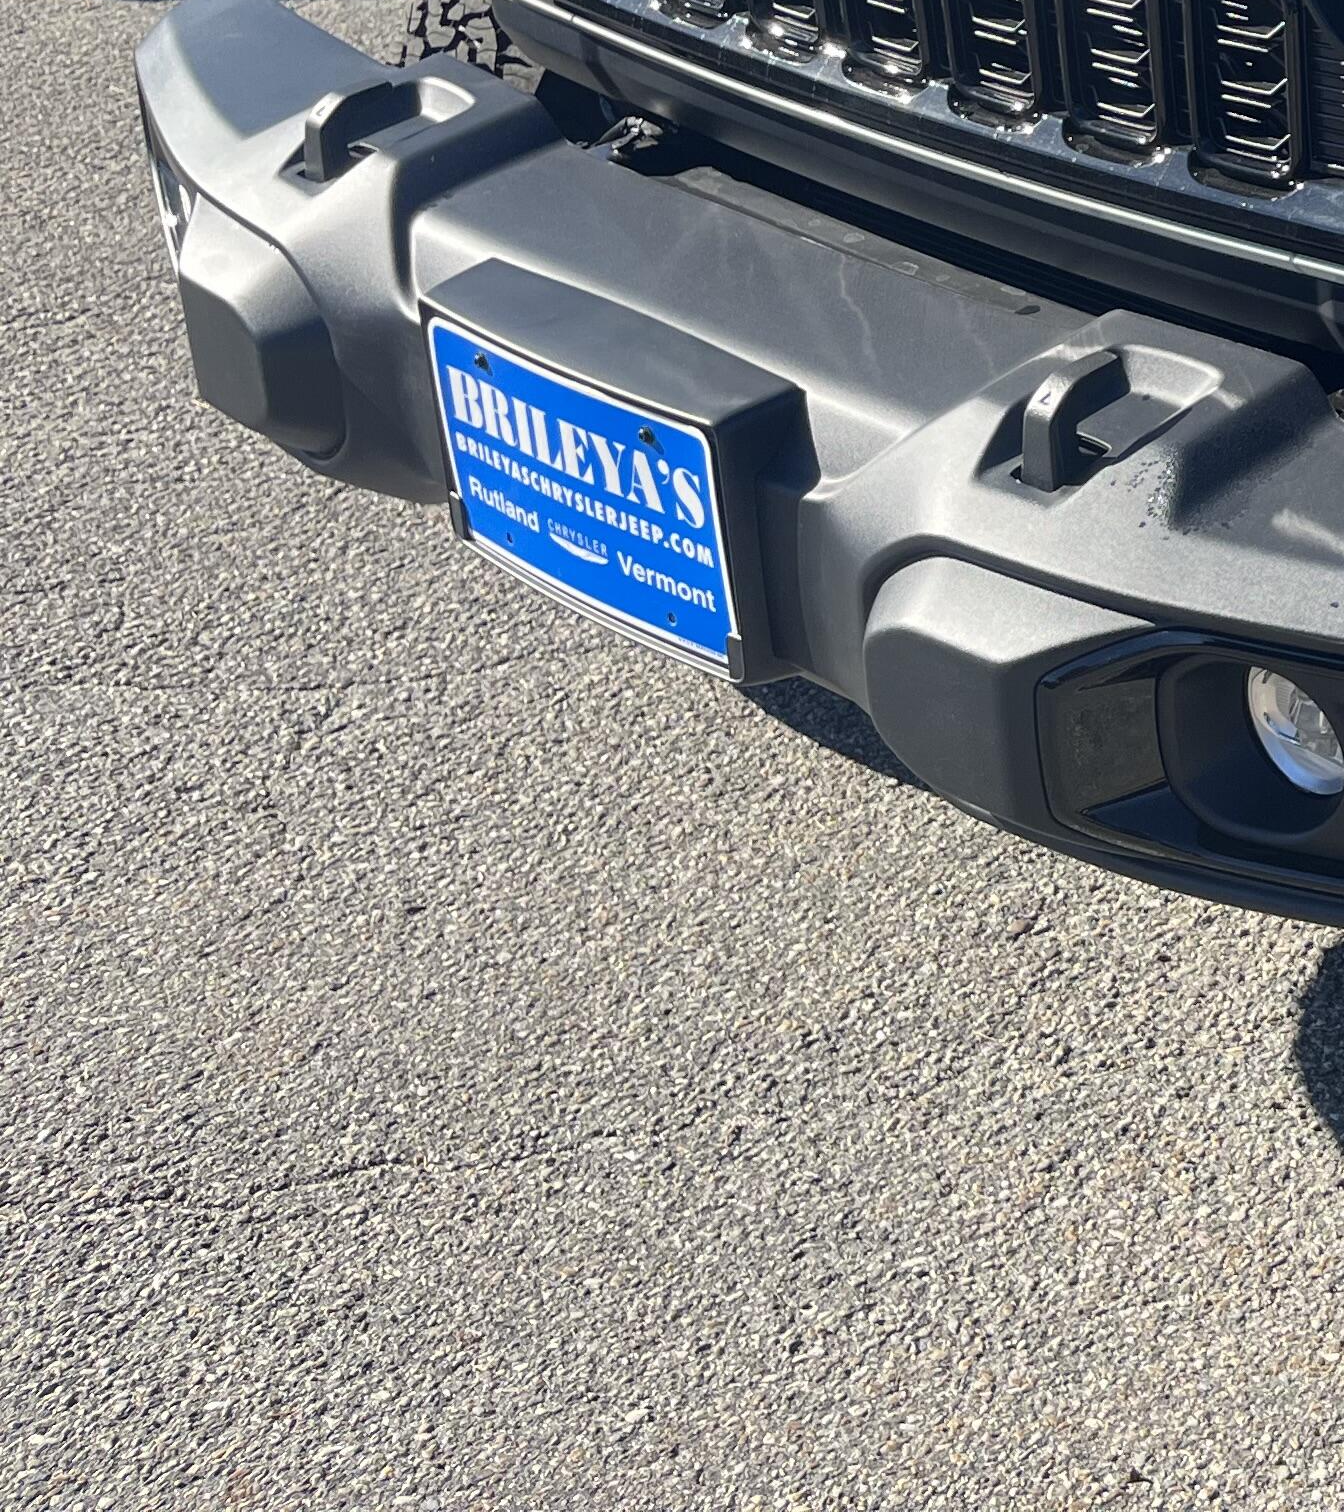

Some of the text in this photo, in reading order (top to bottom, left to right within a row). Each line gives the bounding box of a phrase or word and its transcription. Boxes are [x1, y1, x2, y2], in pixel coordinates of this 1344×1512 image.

[446, 364, 705, 530] BRILEYA'S
[455, 431, 714, 569] BRILEYASCHRYSLERJEEP.COM
[468, 474, 540, 534] Rutland
[547, 518, 609, 557] CHRYSLER
[616, 550, 717, 613] Vermont
